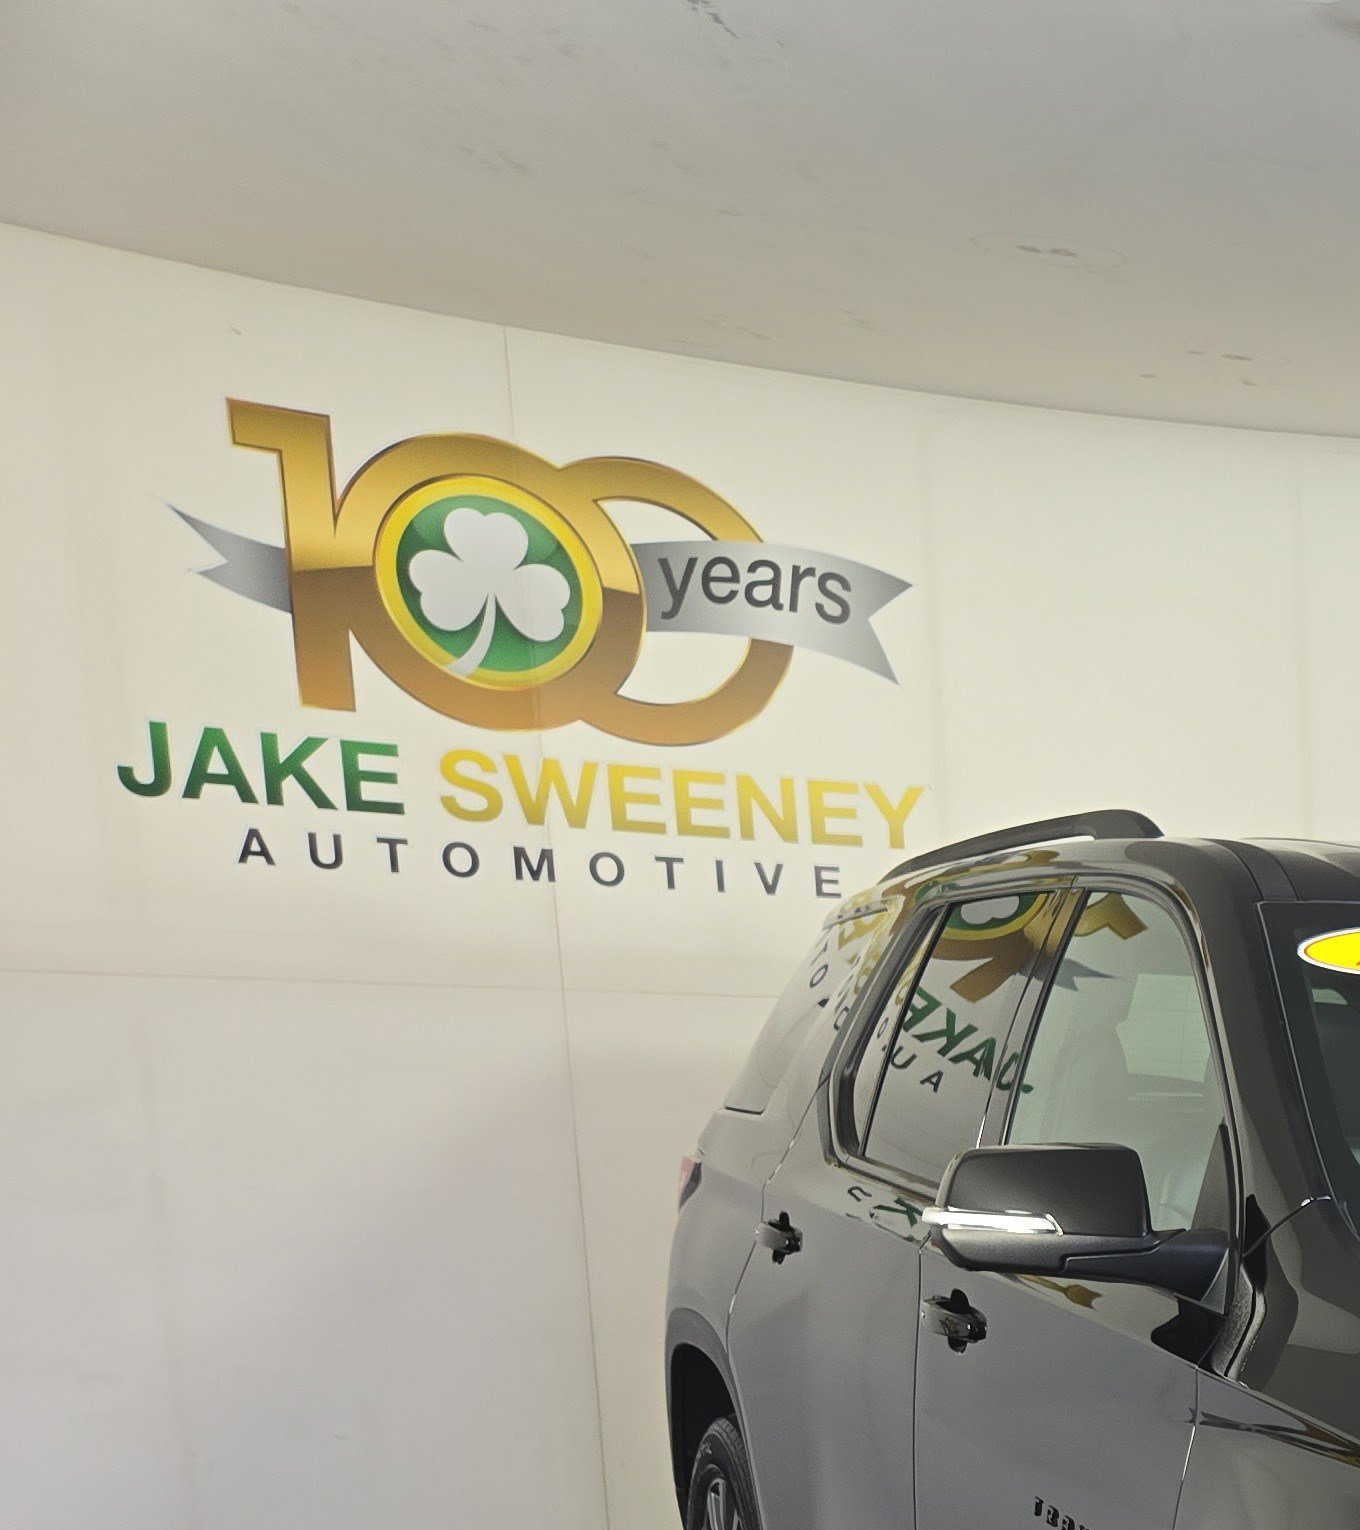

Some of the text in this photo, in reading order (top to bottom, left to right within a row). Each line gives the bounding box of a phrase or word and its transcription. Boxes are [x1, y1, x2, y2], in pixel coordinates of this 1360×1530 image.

[225, 398, 853, 746] 100 years
[116, 720, 925, 850] JAKE SWEENEY
[236, 827, 844, 899] AUTOMOTIVE
